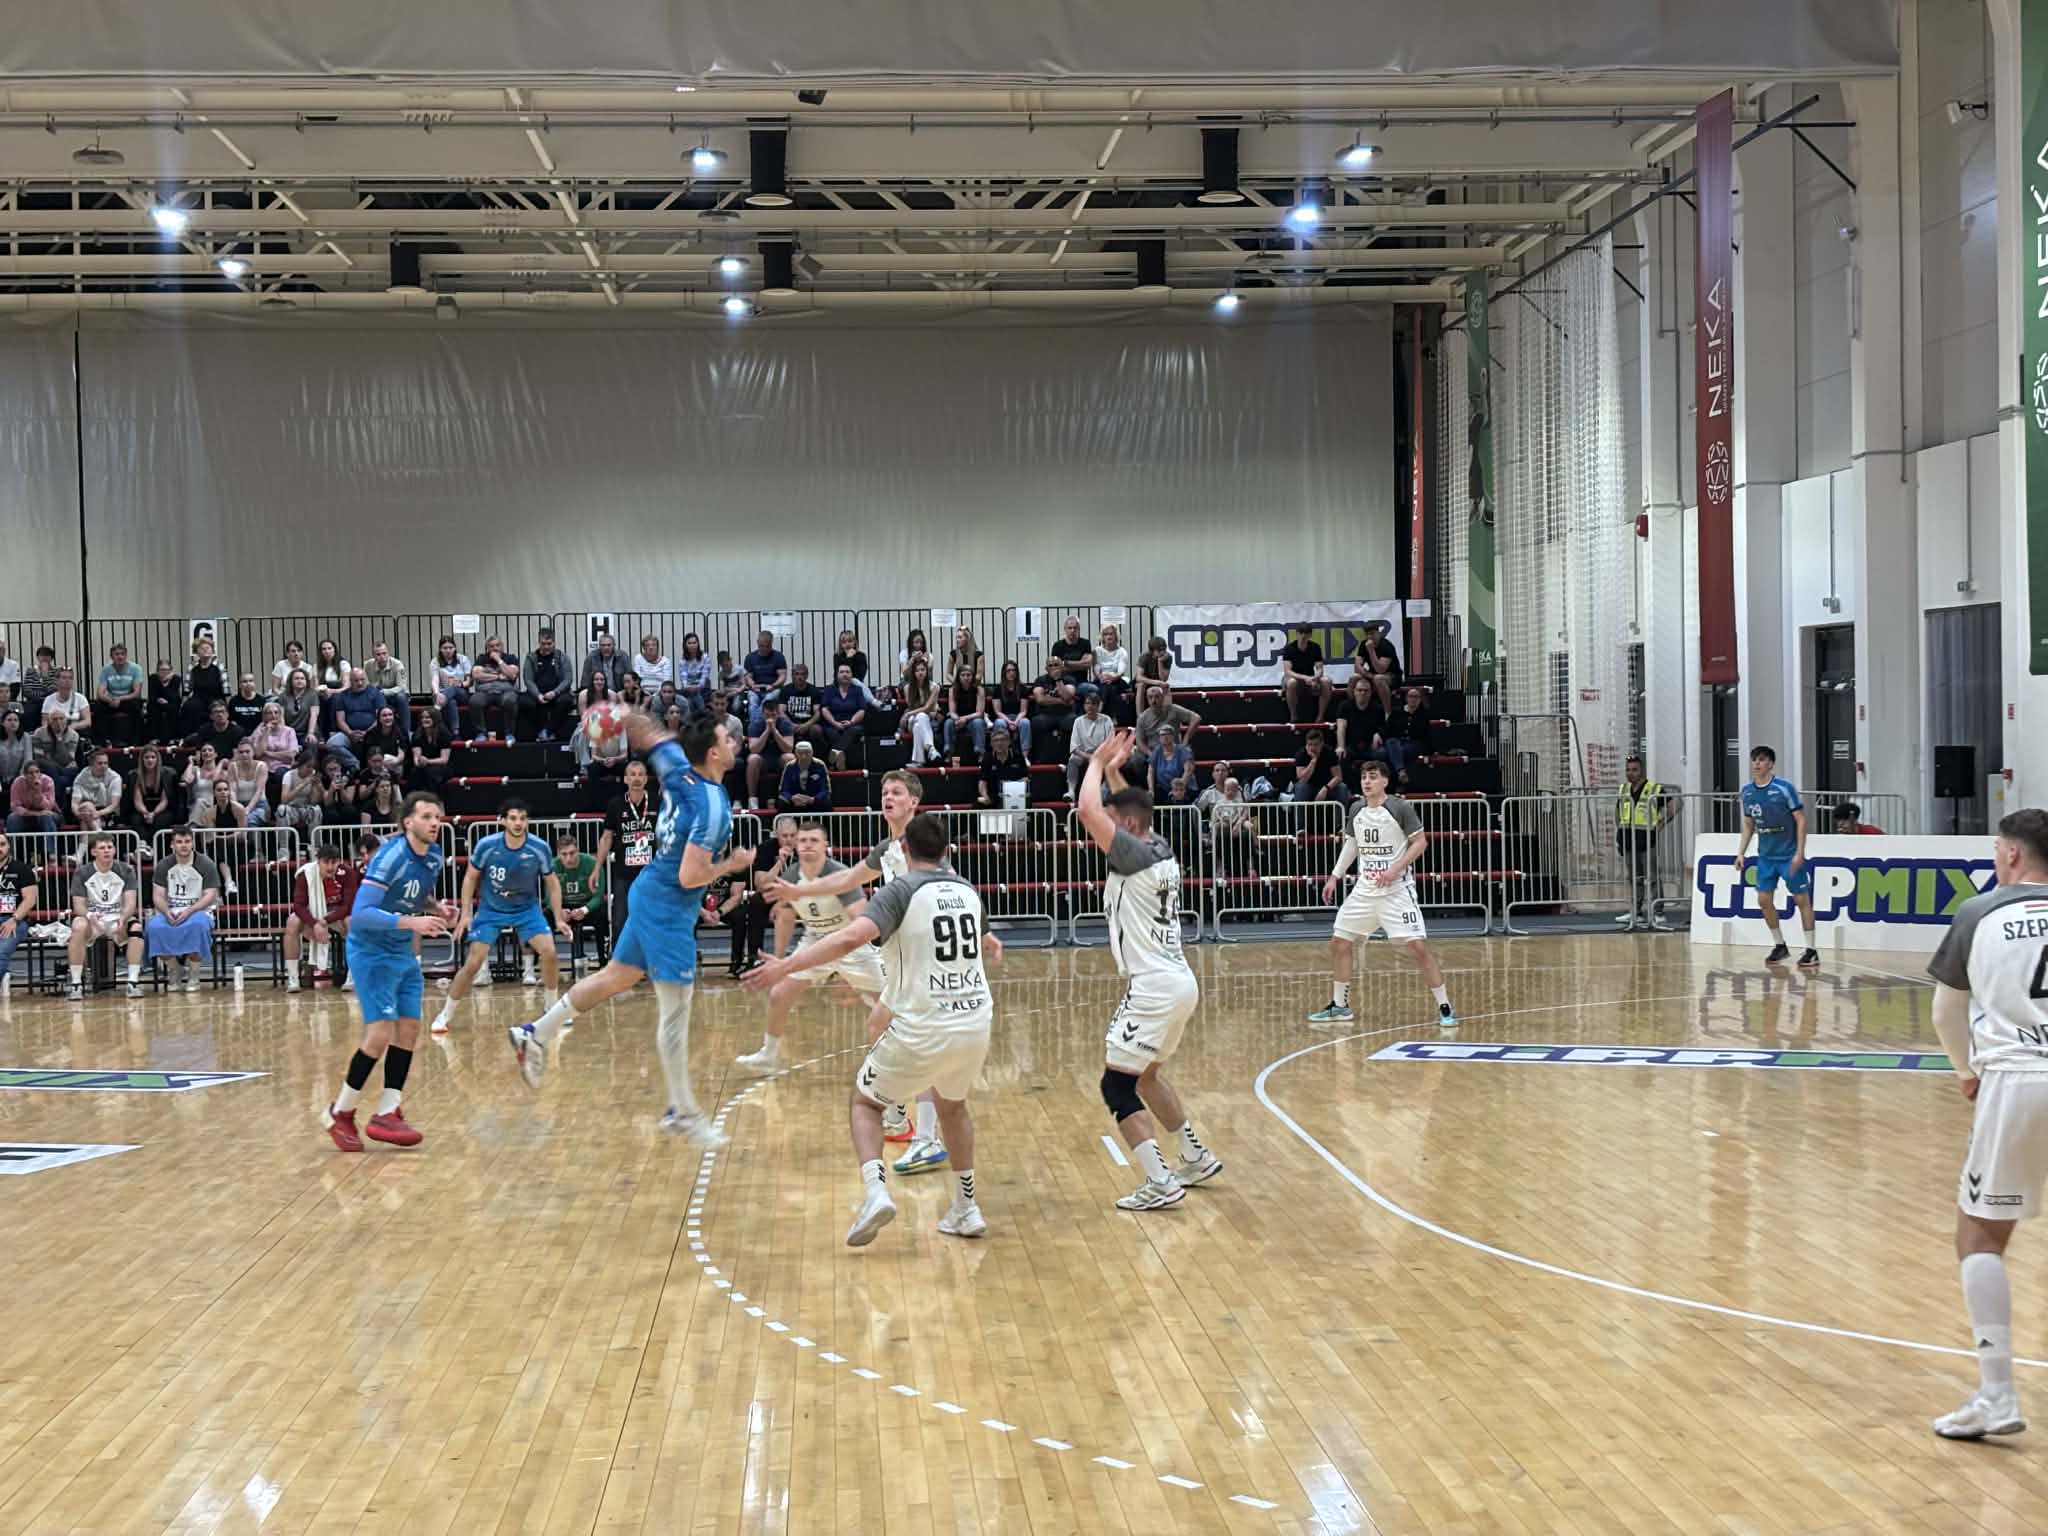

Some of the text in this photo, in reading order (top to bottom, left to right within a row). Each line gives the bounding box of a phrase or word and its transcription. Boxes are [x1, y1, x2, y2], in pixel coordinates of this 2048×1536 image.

[1703, 279, 1721, 418] NEKA
[194, 622, 213, 640] G
[591, 616, 609, 642] H
[1364, 828, 1379, 843] 90
[489, 865, 507, 882] 38
[101, 889, 109, 901] 3
[175, 883, 187, 896] 11
[403, 879, 421, 899] 10
[1402, 911, 1417, 924] 90
[933, 914, 979, 962] 99
[1151, 928, 1177, 945] NE
[930, 966, 983, 991] NEKA
[1414, 1045, 1956, 1069] TiPPMI
